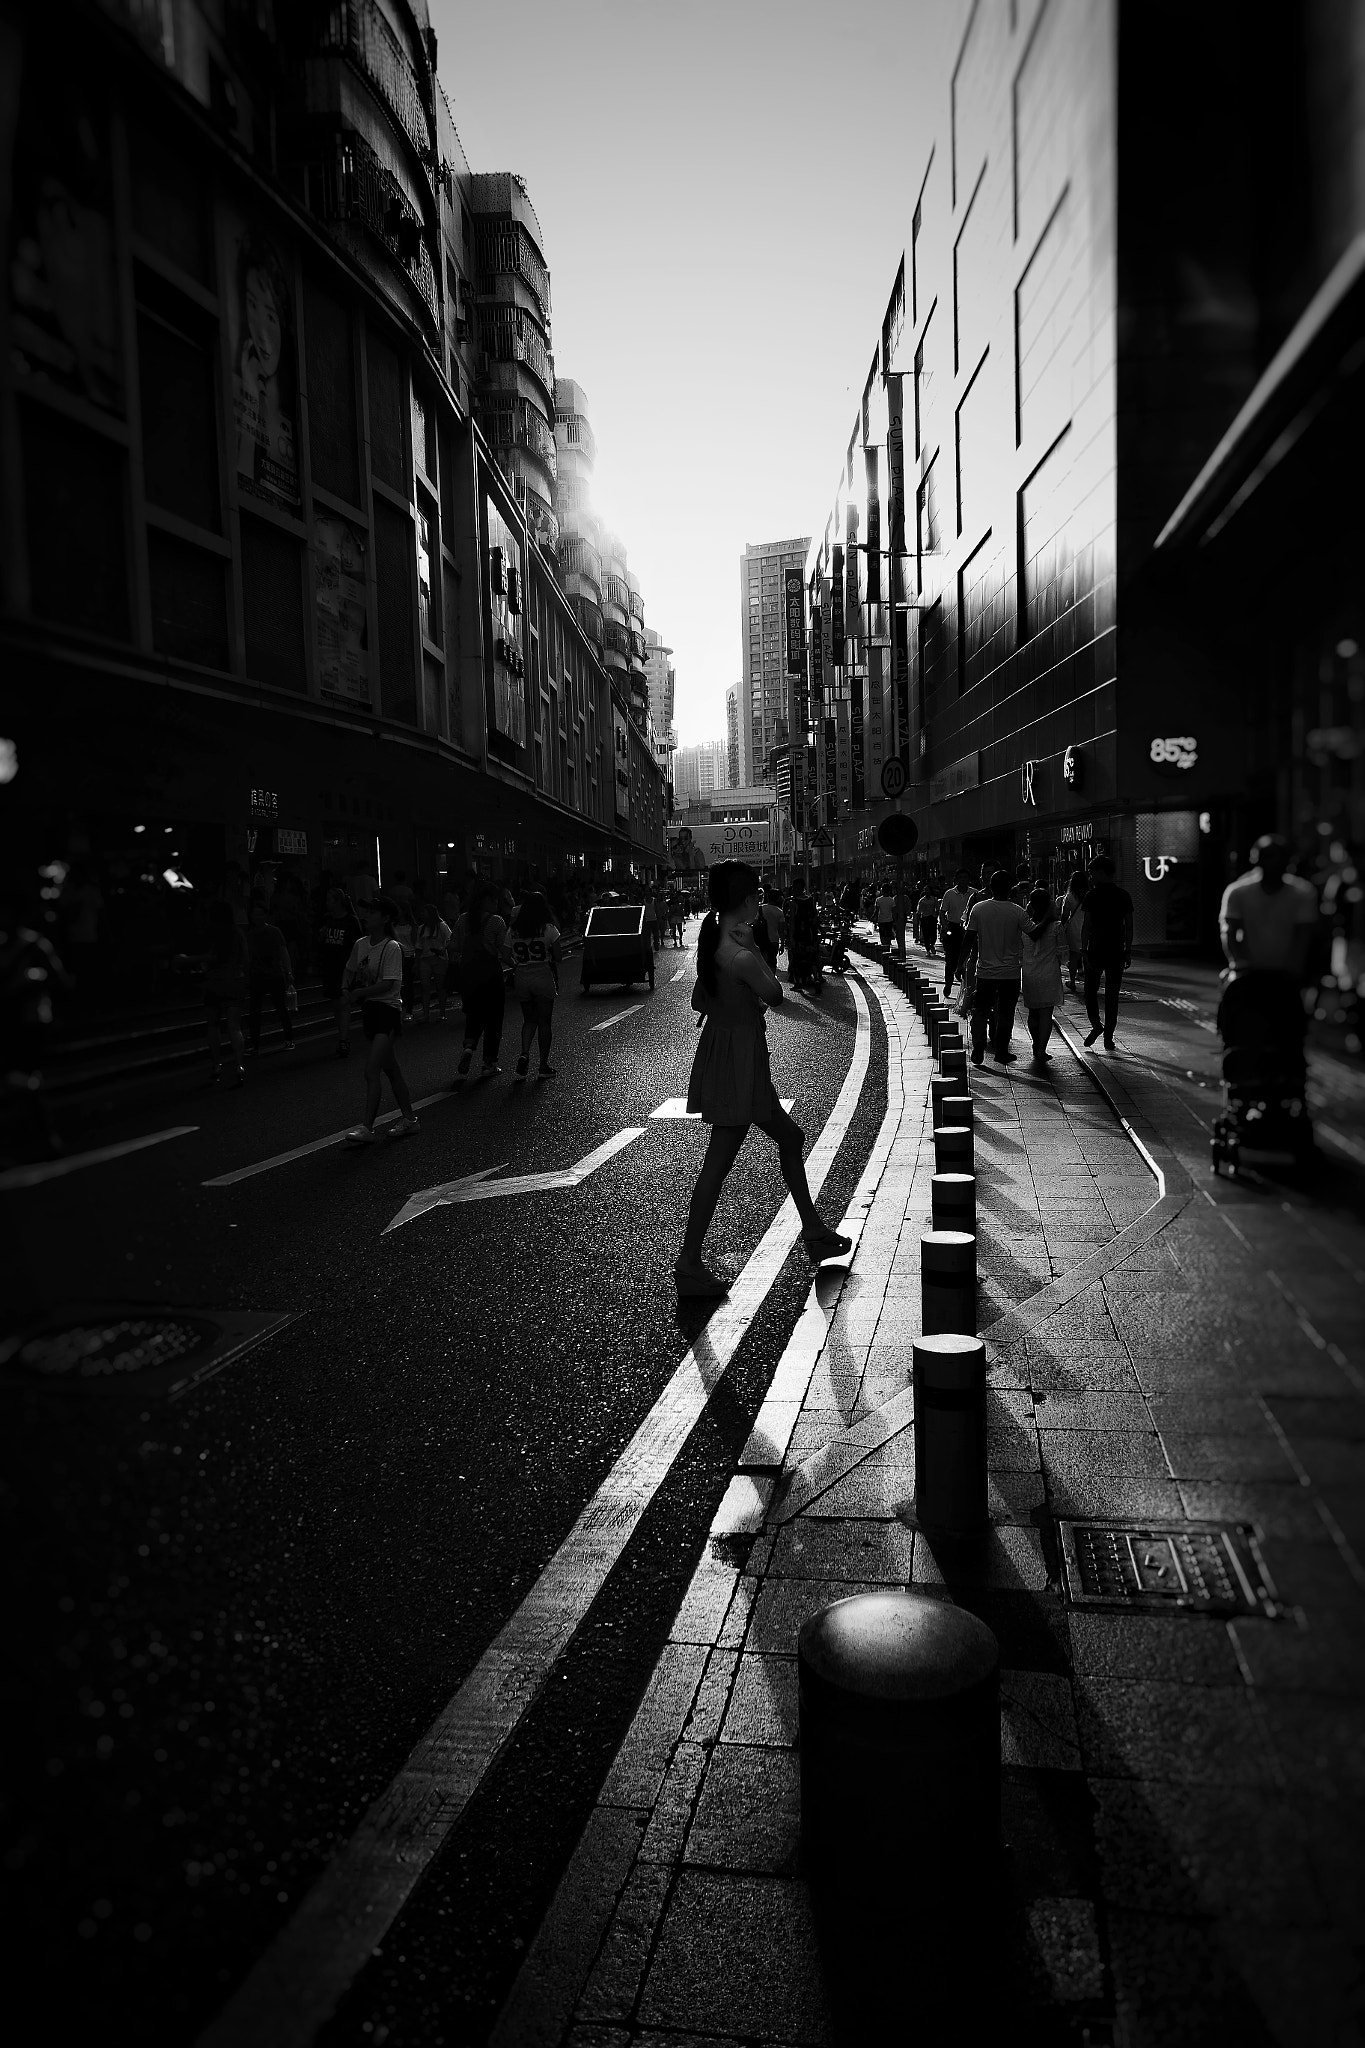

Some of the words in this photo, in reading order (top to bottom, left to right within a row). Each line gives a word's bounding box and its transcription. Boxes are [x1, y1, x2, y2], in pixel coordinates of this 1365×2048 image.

[890, 415, 903, 452] SUN
[891, 466, 904, 516] PLAZA
[846, 531, 857, 560] SN
[846, 570, 858, 608] PLAZA
[821, 602, 832, 625] SUN
[822, 632, 834, 664] PLAZA
[852, 706, 863, 735] SUN
[825, 742, 836, 766] SUN
[851, 743, 864, 783] PLAZA
[886, 766, 901, 788] 20
[709, 841, 769, 854] 东门眼镜城
[513, 940, 546, 963] 99
